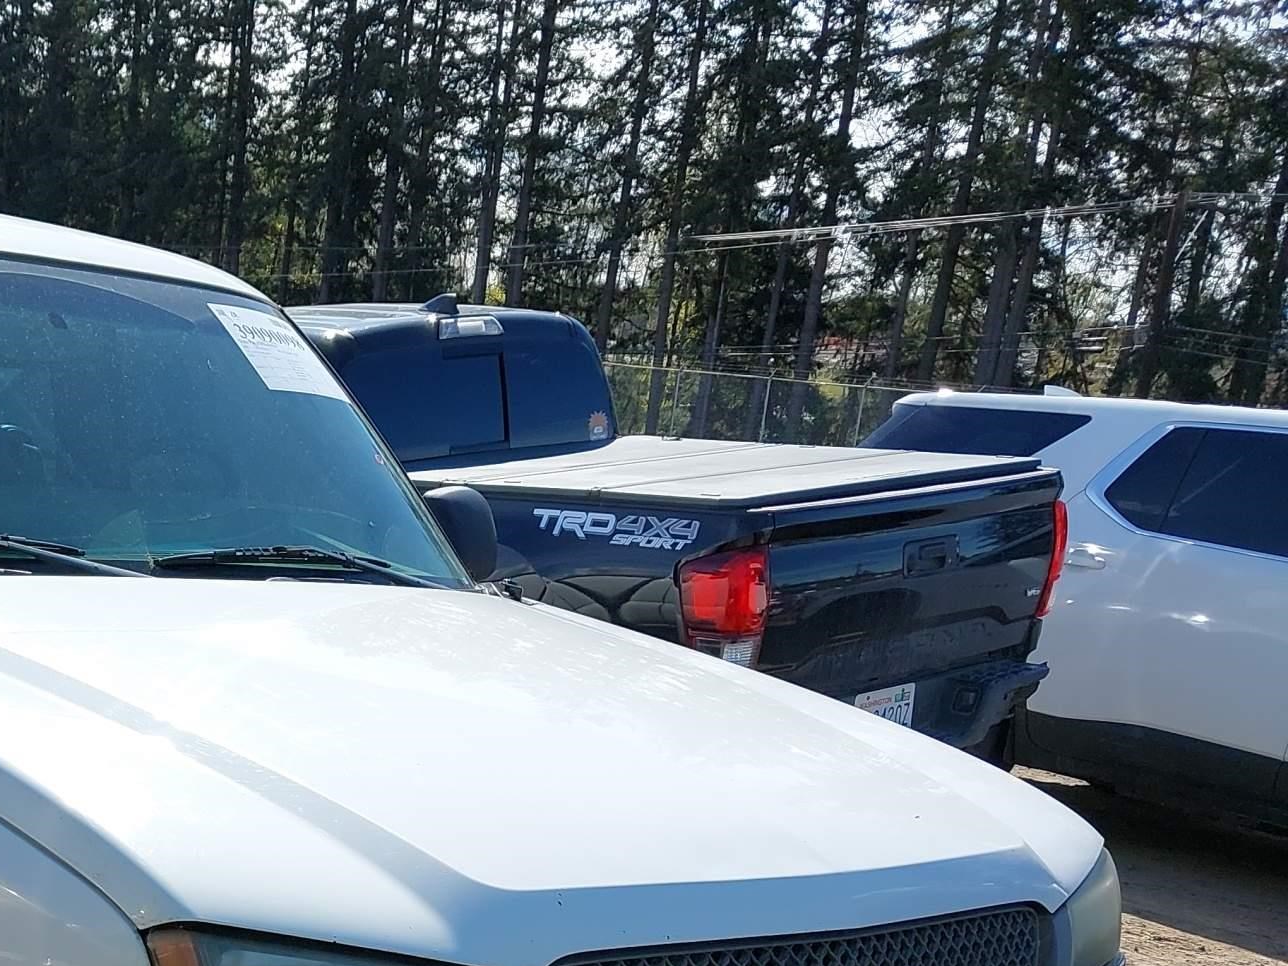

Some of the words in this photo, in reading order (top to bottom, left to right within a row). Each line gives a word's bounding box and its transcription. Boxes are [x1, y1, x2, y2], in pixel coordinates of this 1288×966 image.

[533, 508, 616, 540] TRD
[616, 515, 700, 541] 4X4
[609, 534, 692, 551] SPORT
